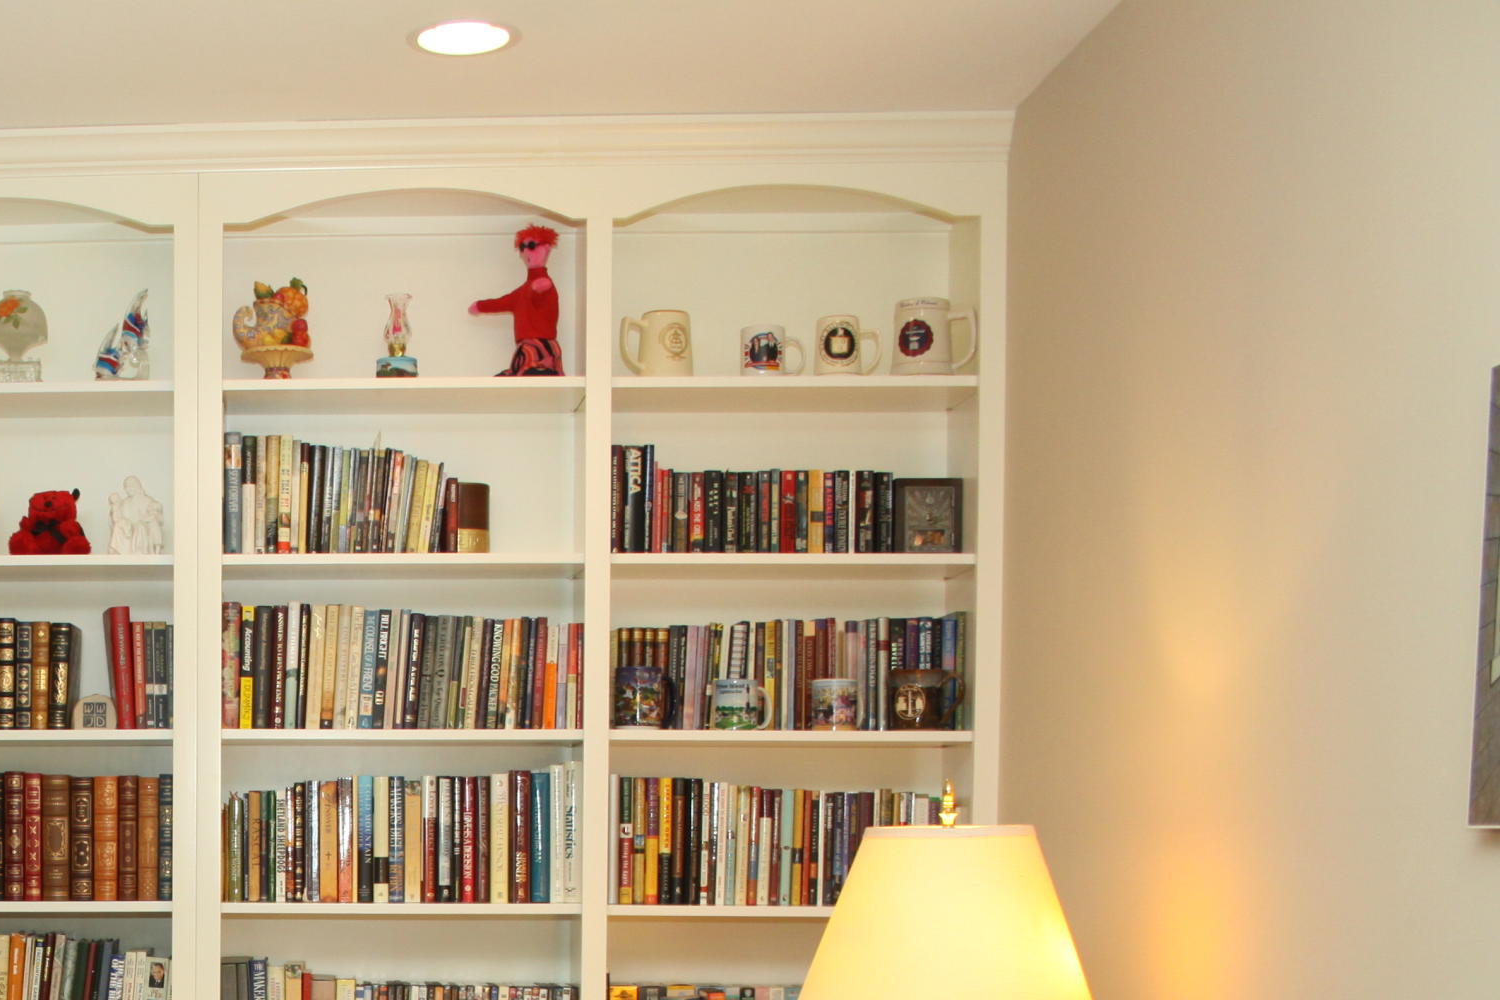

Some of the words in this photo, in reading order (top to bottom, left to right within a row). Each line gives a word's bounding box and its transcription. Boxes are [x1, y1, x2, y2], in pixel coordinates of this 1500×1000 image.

[628, 448, 642, 495] ATTICA
[363, 626, 377, 655] COUNSEL
[380, 614, 391, 631] BILL
[243, 627, 254, 672] Accounting
[378, 632, 390, 660] BRIGHT
[491, 623, 504, 663] KNOWING
[362, 668, 374, 692] FRIEND
[490, 663, 500, 682] GOD
[276, 798, 287, 833] SHETLAND
[565, 804, 577, 860] Statistics
[276, 834, 287, 874] SHEEPDOGS
[363, 813, 372, 865] MOUNTAIN
